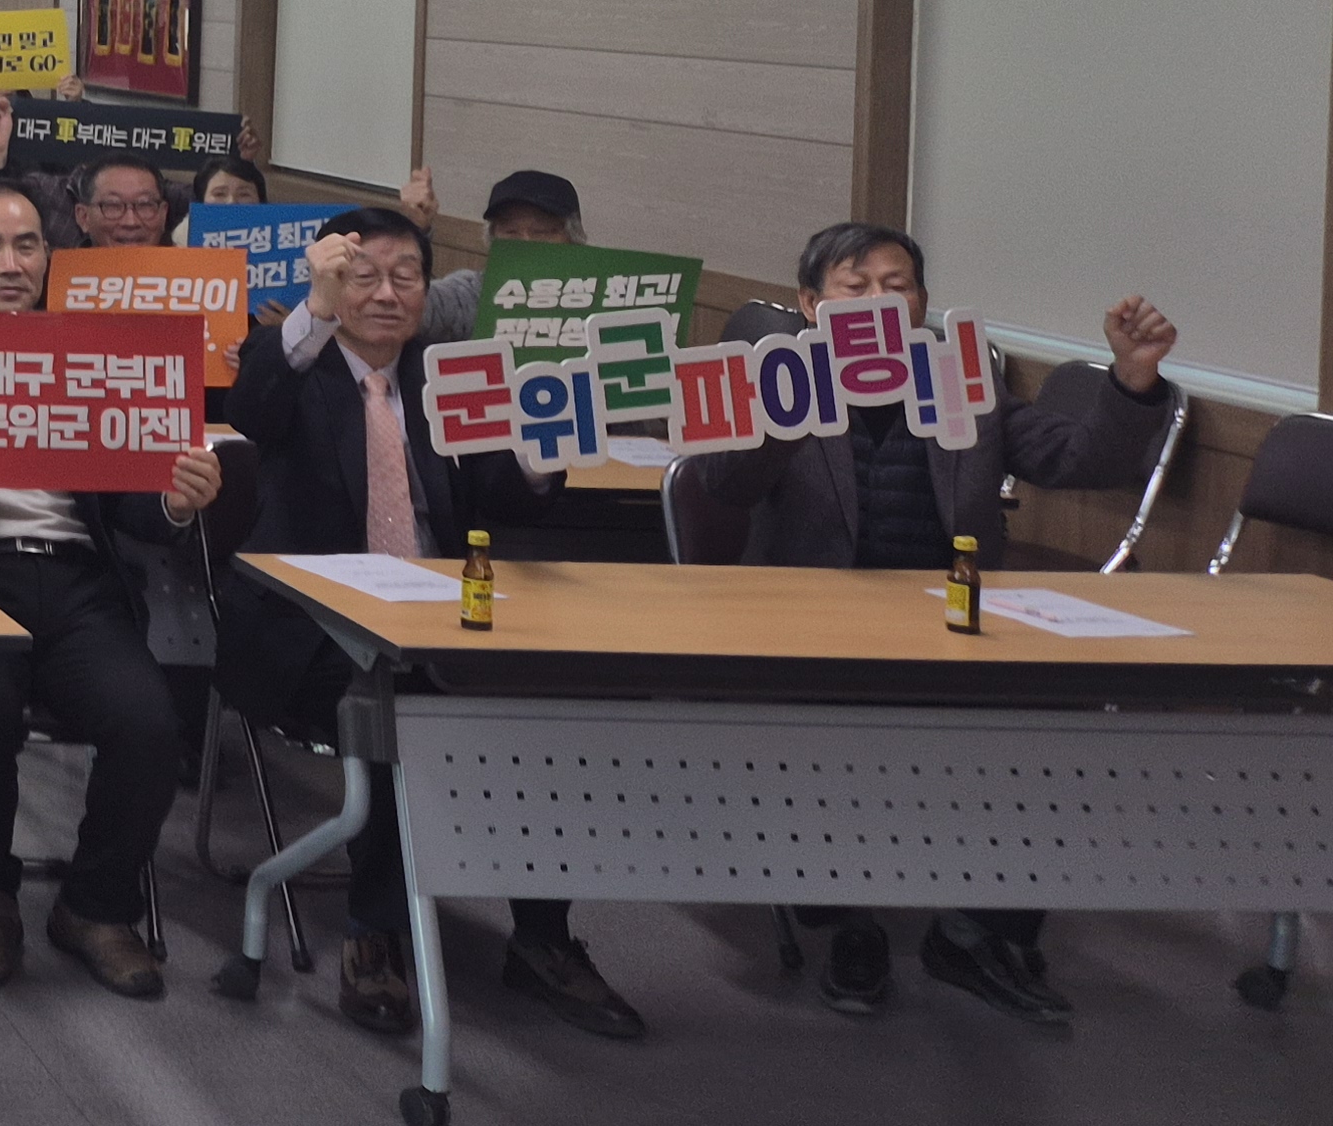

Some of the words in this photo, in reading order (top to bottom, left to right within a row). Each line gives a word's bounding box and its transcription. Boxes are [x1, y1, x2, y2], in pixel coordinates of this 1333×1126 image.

[16, 117, 52, 142] 대구
[131, 126, 167, 151] 대구
[64, 274, 240, 313] 군위군민이
[493, 277, 598, 310] 수용성
[601, 272, 682, 308] 최고!
[64, 351, 187, 400] 군부대
[99, 406, 192, 454] 이전!
